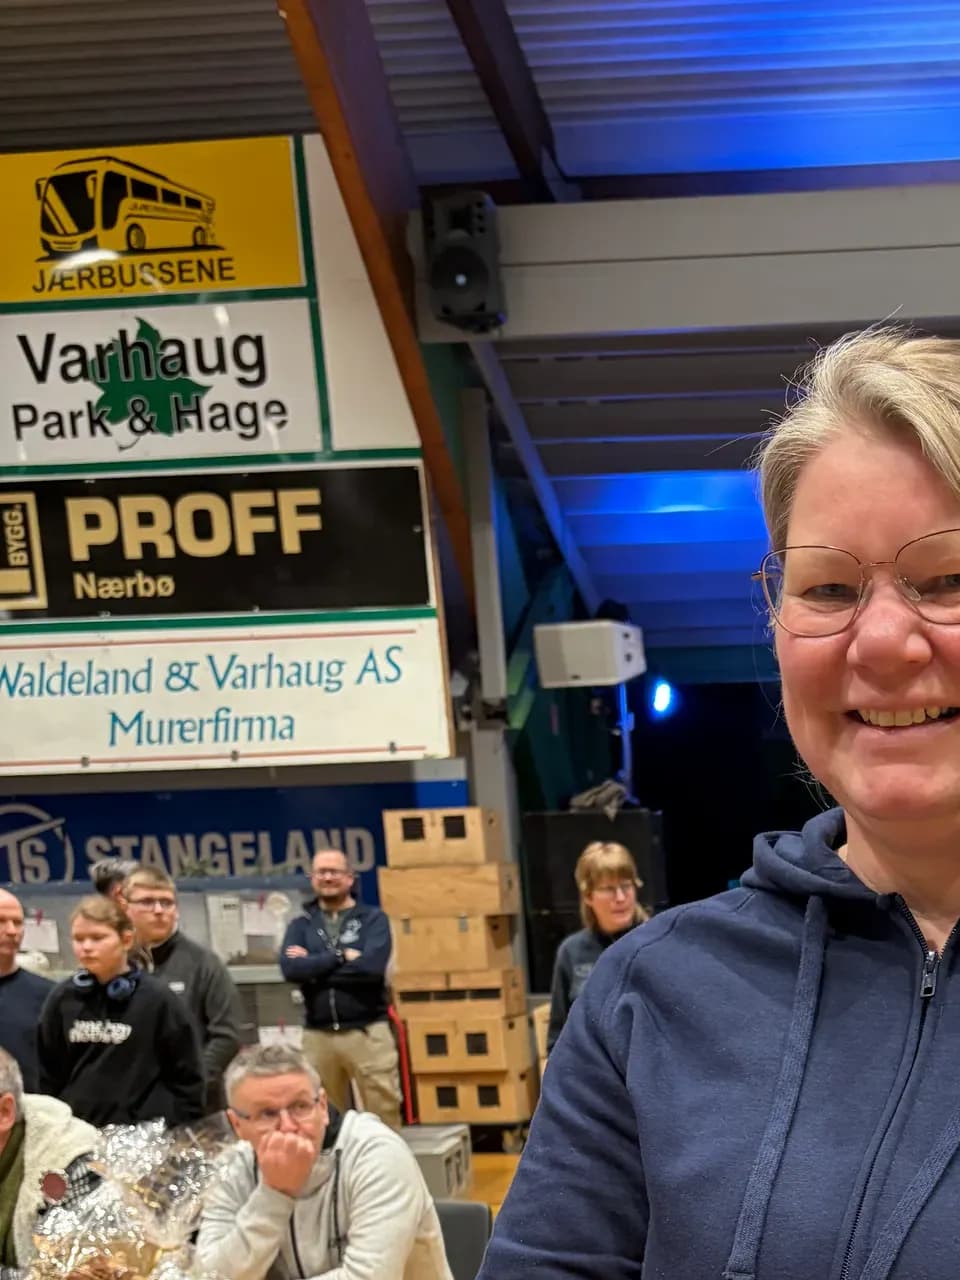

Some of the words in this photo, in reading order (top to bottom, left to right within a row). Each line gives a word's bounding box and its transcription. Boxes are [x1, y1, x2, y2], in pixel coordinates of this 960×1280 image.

[32, 257, 236, 293] JÆRBUSSENE
[17, 329, 267, 387] Varhaug
[13, 402, 111, 441] Park
[128, 398, 155, 433] &
[174, 395, 289, 439] Hage
[65, 488, 322, 561] PROFF
[73, 571, 175, 600] Nærbø
[165, 662, 199, 691] &
[206, 653, 346, 692] Varhaug
[355, 645, 402, 685] AS
[108, 707, 294, 747] Murerfirma
